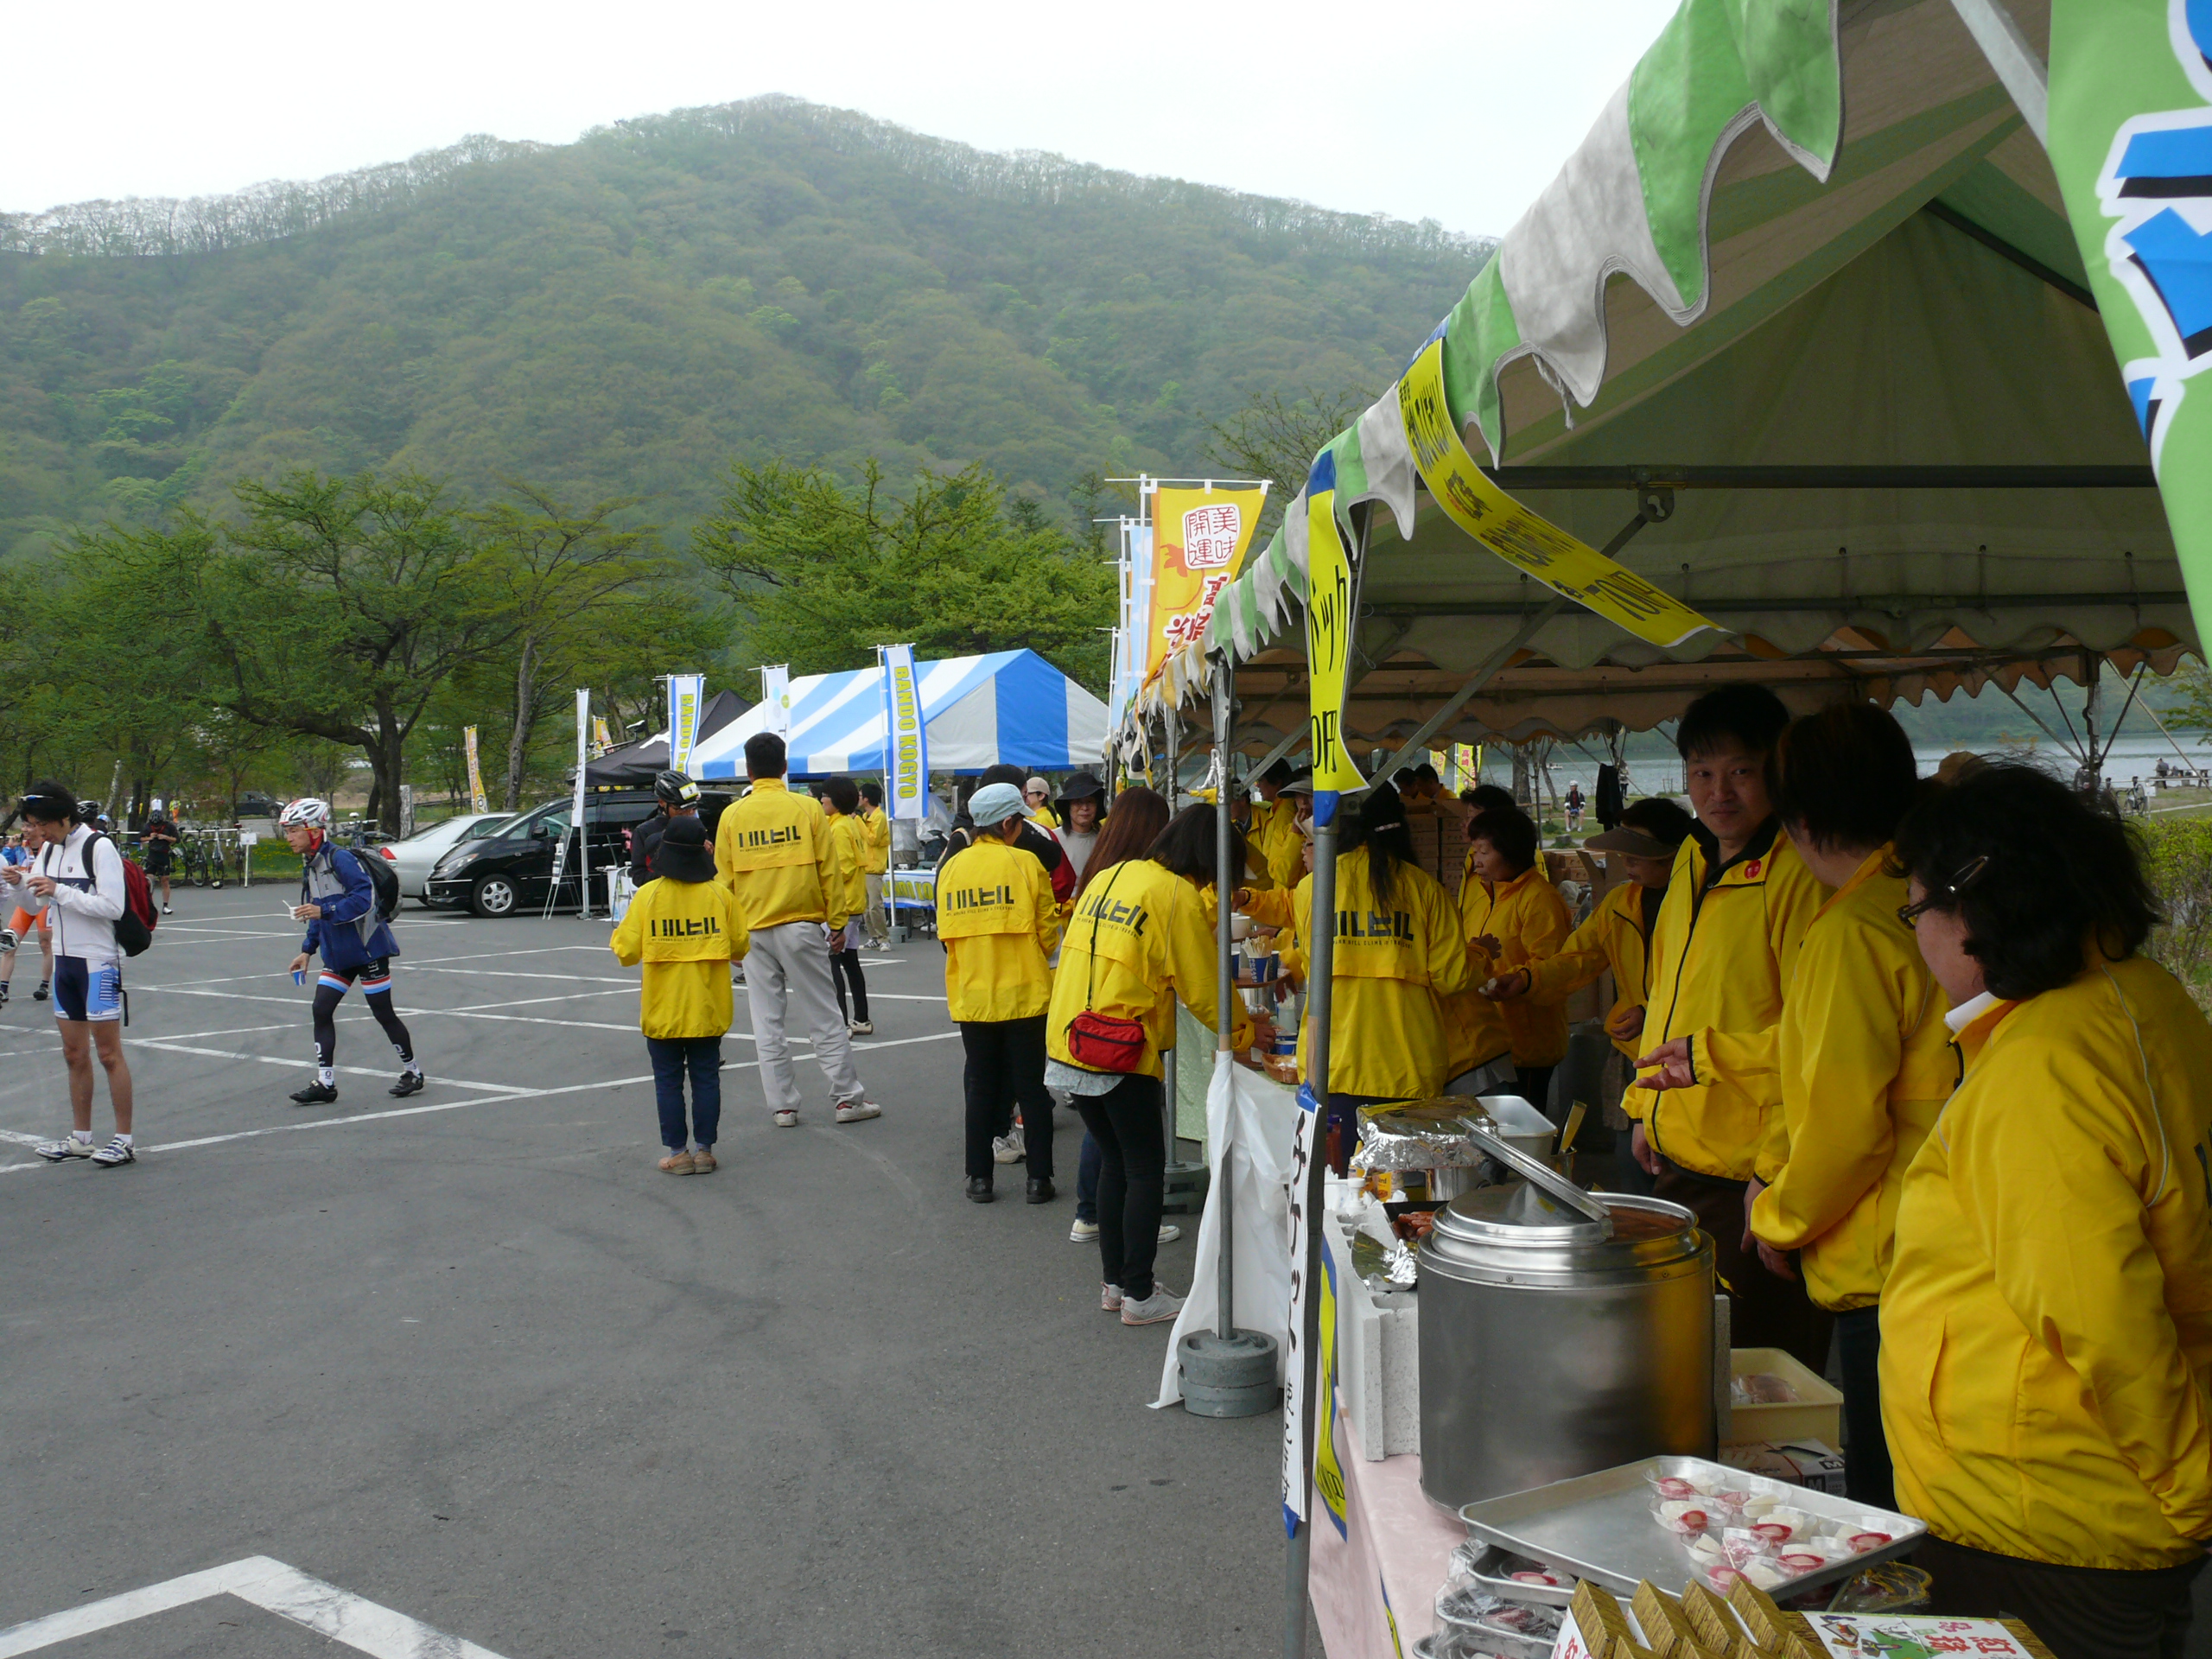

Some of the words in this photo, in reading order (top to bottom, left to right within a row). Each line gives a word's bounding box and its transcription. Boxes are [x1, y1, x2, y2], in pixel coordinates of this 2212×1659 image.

[1188, 511, 1215, 566] 開運
[680, 694, 694, 748] BANDO
[894, 666, 916, 731] BANDO
[898, 734, 918, 799] KOGYO
